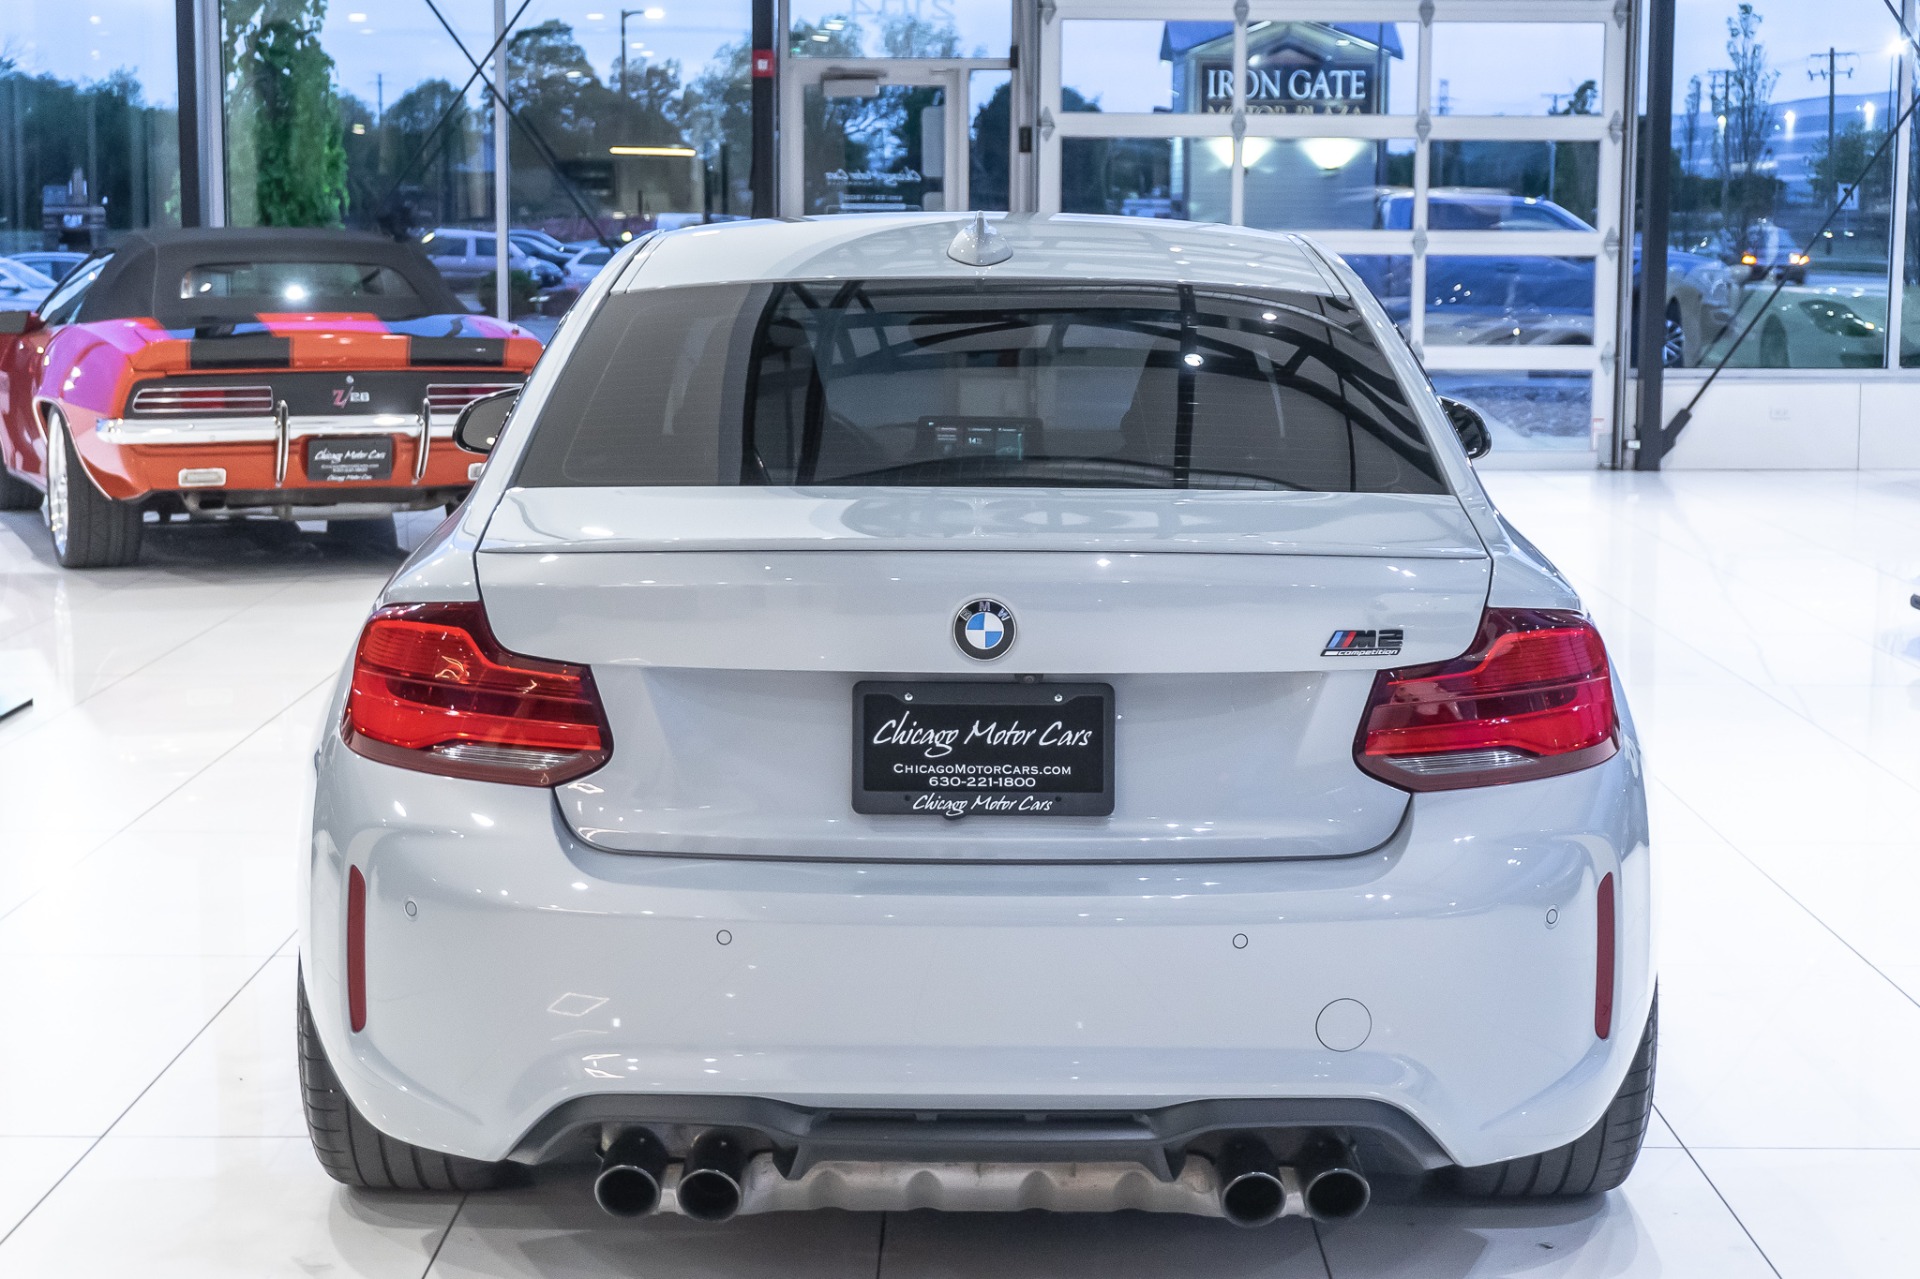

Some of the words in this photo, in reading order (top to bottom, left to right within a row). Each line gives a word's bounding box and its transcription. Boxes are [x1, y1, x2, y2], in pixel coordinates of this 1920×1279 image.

[1207, 69, 1281, 99] IRON
[1288, 69, 1366, 99] GATE
[960, 601, 1010, 621] BMW
[1348, 630, 1403, 648] M2
[873, 711, 959, 757] Chicago
[964, 720, 1036, 745] Motor
[1039, 721, 1092, 746] Cars
[929, 777, 1036, 787] 630-221-1800
[912, 793, 968, 816] Chicago
[971, 795, 1017, 810] Motor
[1018, 796, 1052, 811] Cars
